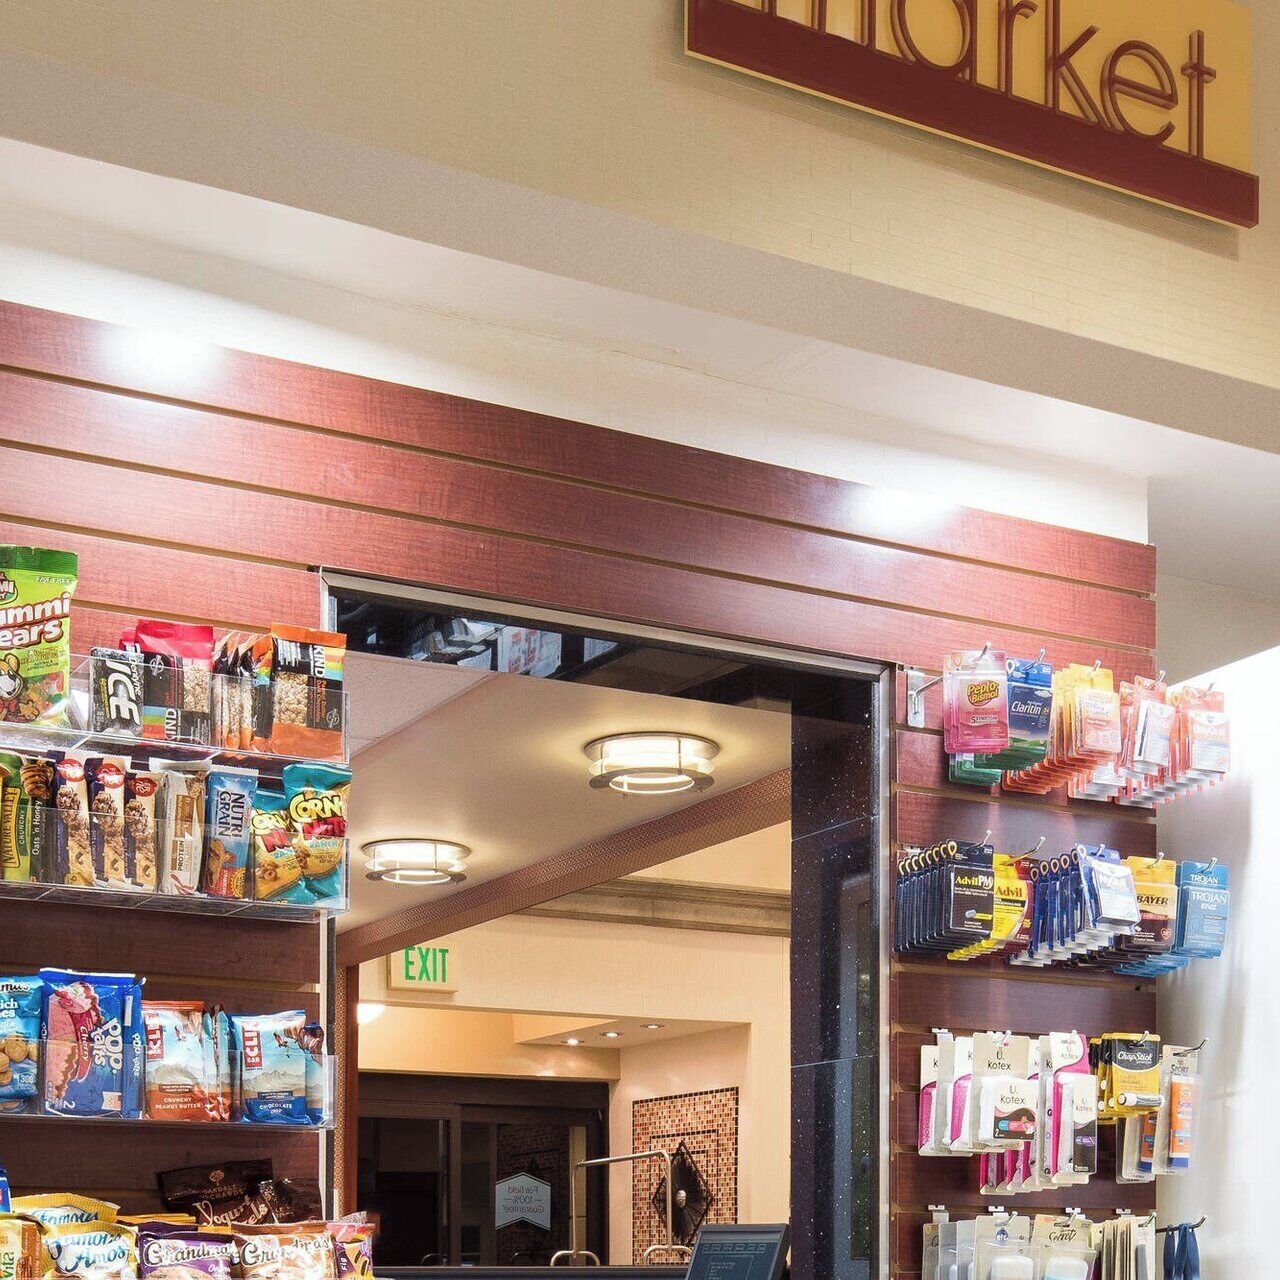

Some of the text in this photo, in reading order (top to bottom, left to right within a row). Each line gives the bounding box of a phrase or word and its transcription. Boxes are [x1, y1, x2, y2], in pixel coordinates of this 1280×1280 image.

[313, 645, 324, 677] KIND
[1011, 700, 1041, 714] Claritin
[32, 799, 43, 855] Oats Honey
[218, 791, 232, 837] GRAIN
[230, 792, 246, 838] NUTRI
[177, 840, 185, 871] PROTEIN
[995, 887, 1023, 898] Advil
[1190, 874, 1219, 884] TROJAN
[1137, 895, 1169, 905] BAYER
[1190, 892, 1227, 904] TROJAN
[403, 945, 449, 983] EXIT
